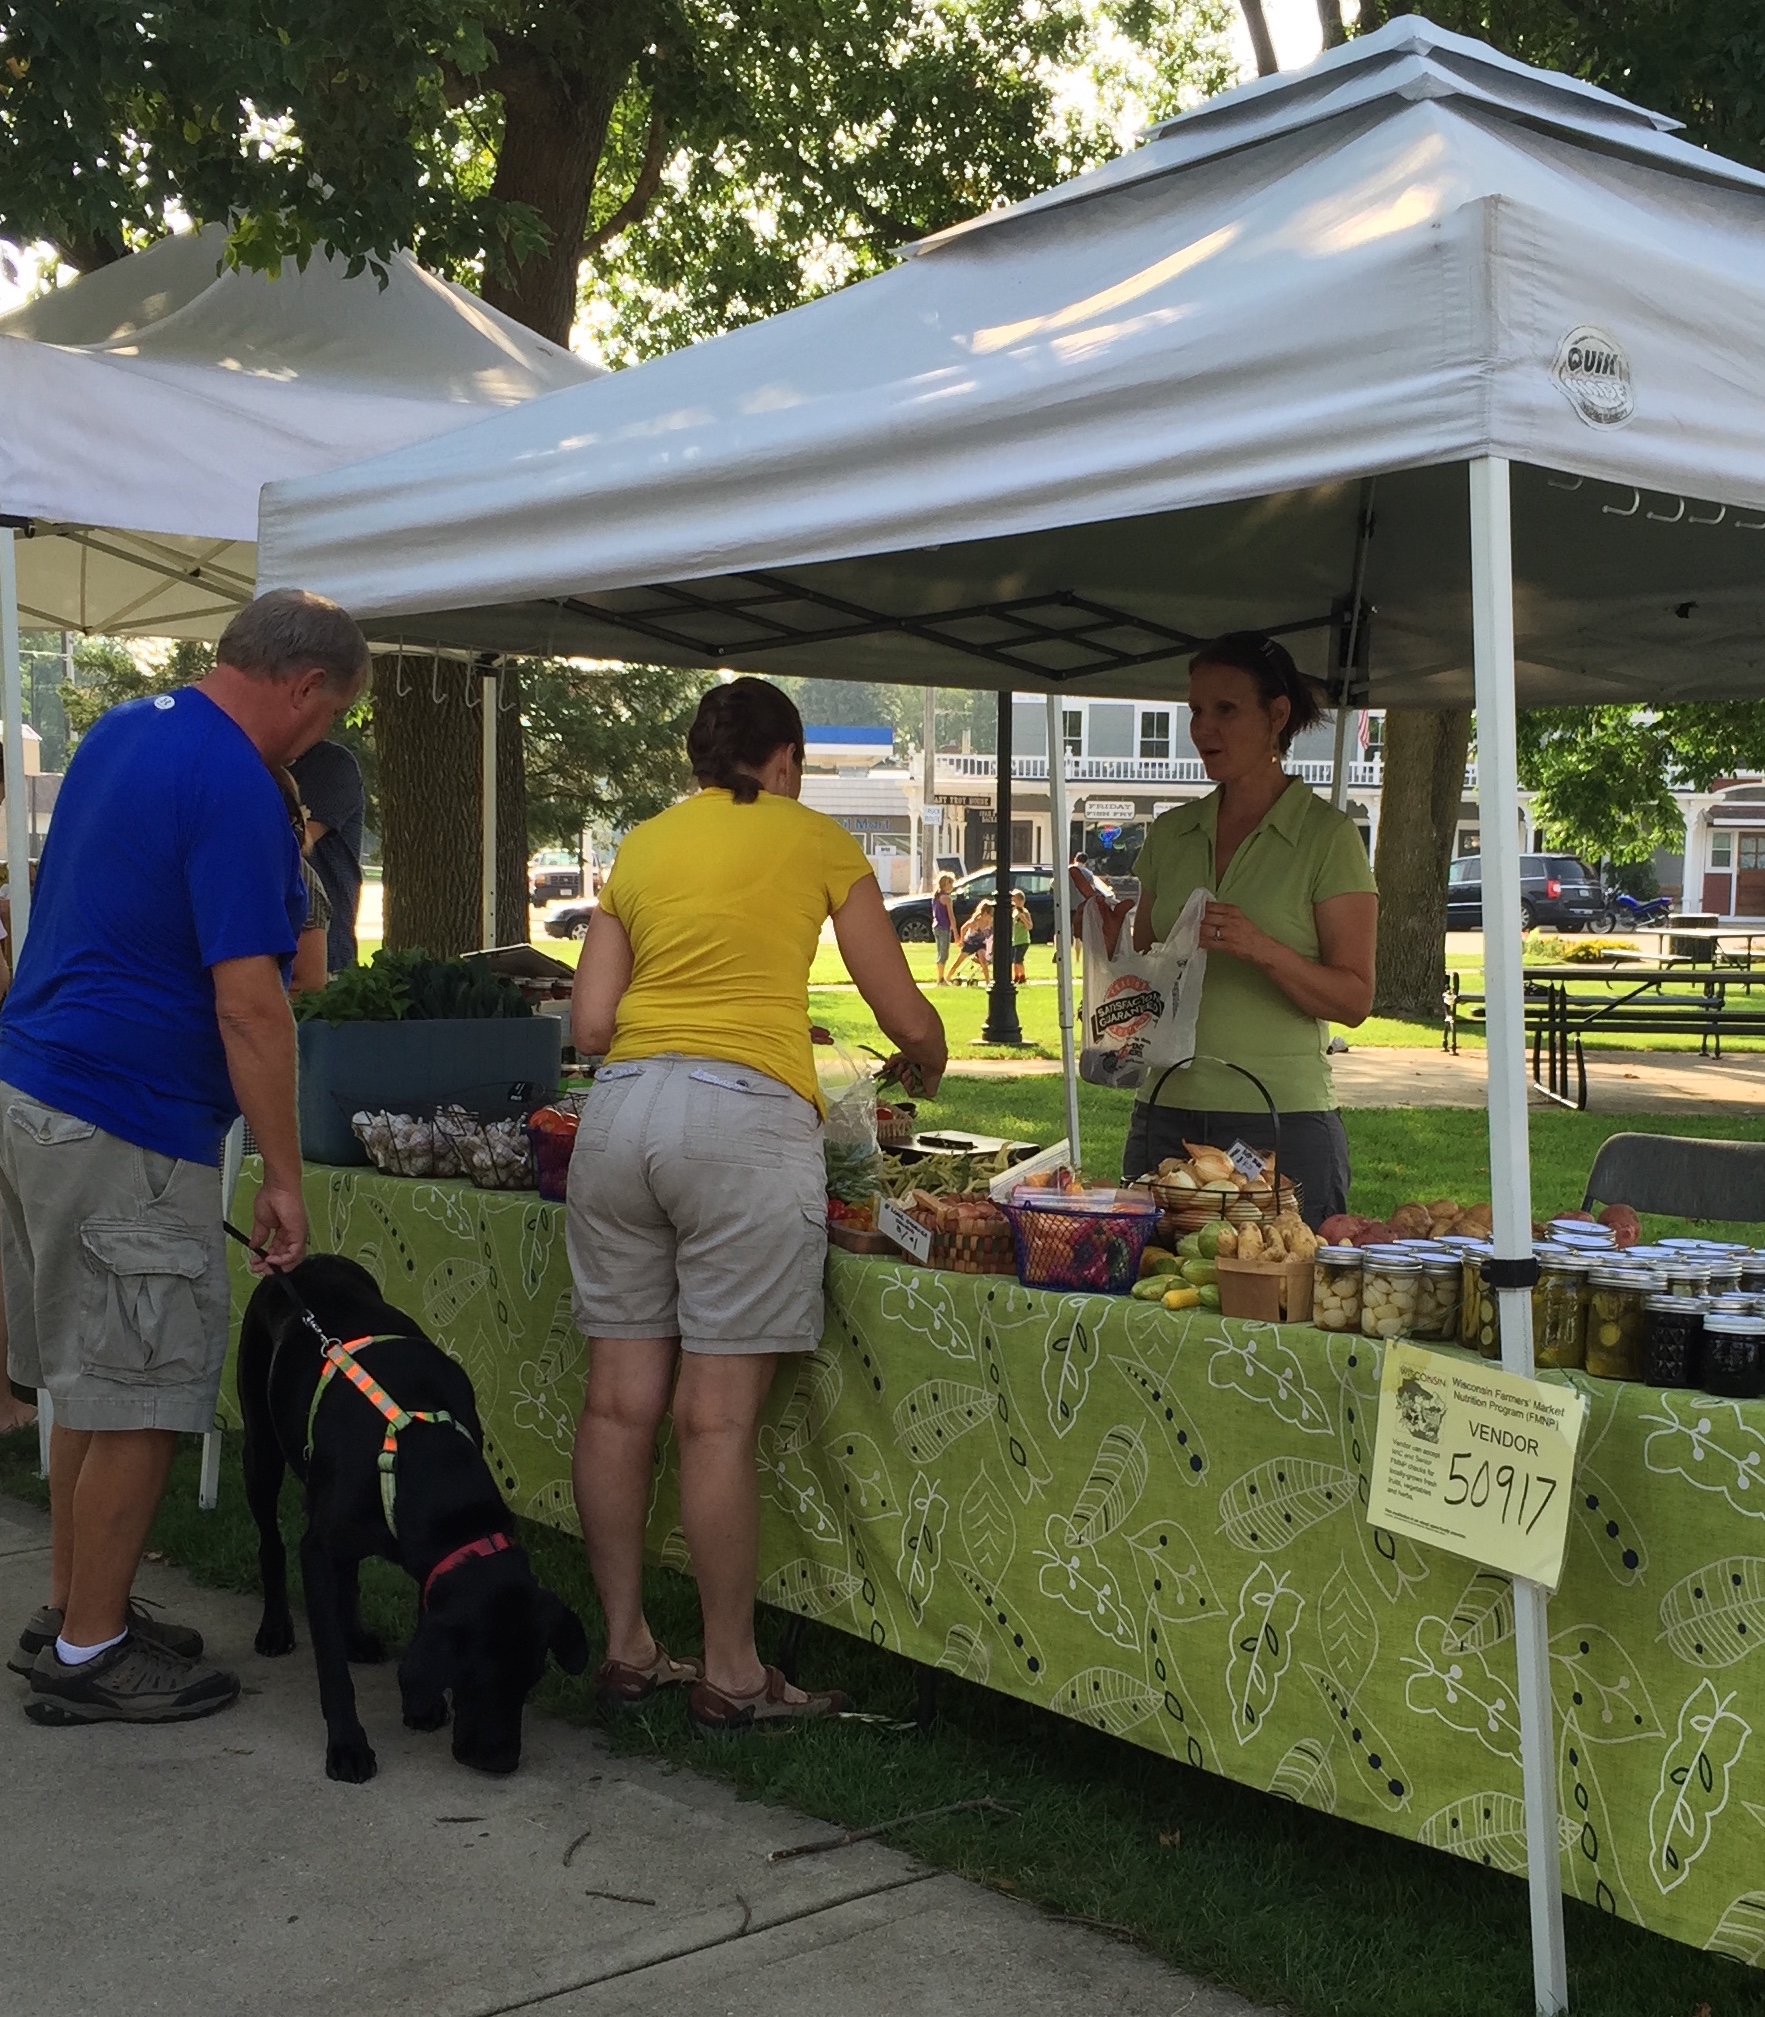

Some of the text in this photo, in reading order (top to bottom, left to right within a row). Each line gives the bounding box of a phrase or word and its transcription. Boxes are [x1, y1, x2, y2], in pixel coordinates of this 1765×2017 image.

[1567, 346, 1619, 376] QUIK
[934, 796, 947, 804] AST
[949, 797, 966, 805] TROY
[855, 817, 891, 831] Mart
[1097, 992, 1159, 1017] SATISFACTION
[1099, 1001, 1159, 1027] GUARANTEED
[1400, 1365, 1446, 1387] WISCONSIN
[1452, 1377, 1565, 1417] Wisconsin Farmers' Market
[1453, 1390, 1559, 1431] Nutrition Program (FMNP)
[1468, 1420, 1539, 1457] VENDOR
[1444, 1452, 1557, 1536] 50917
